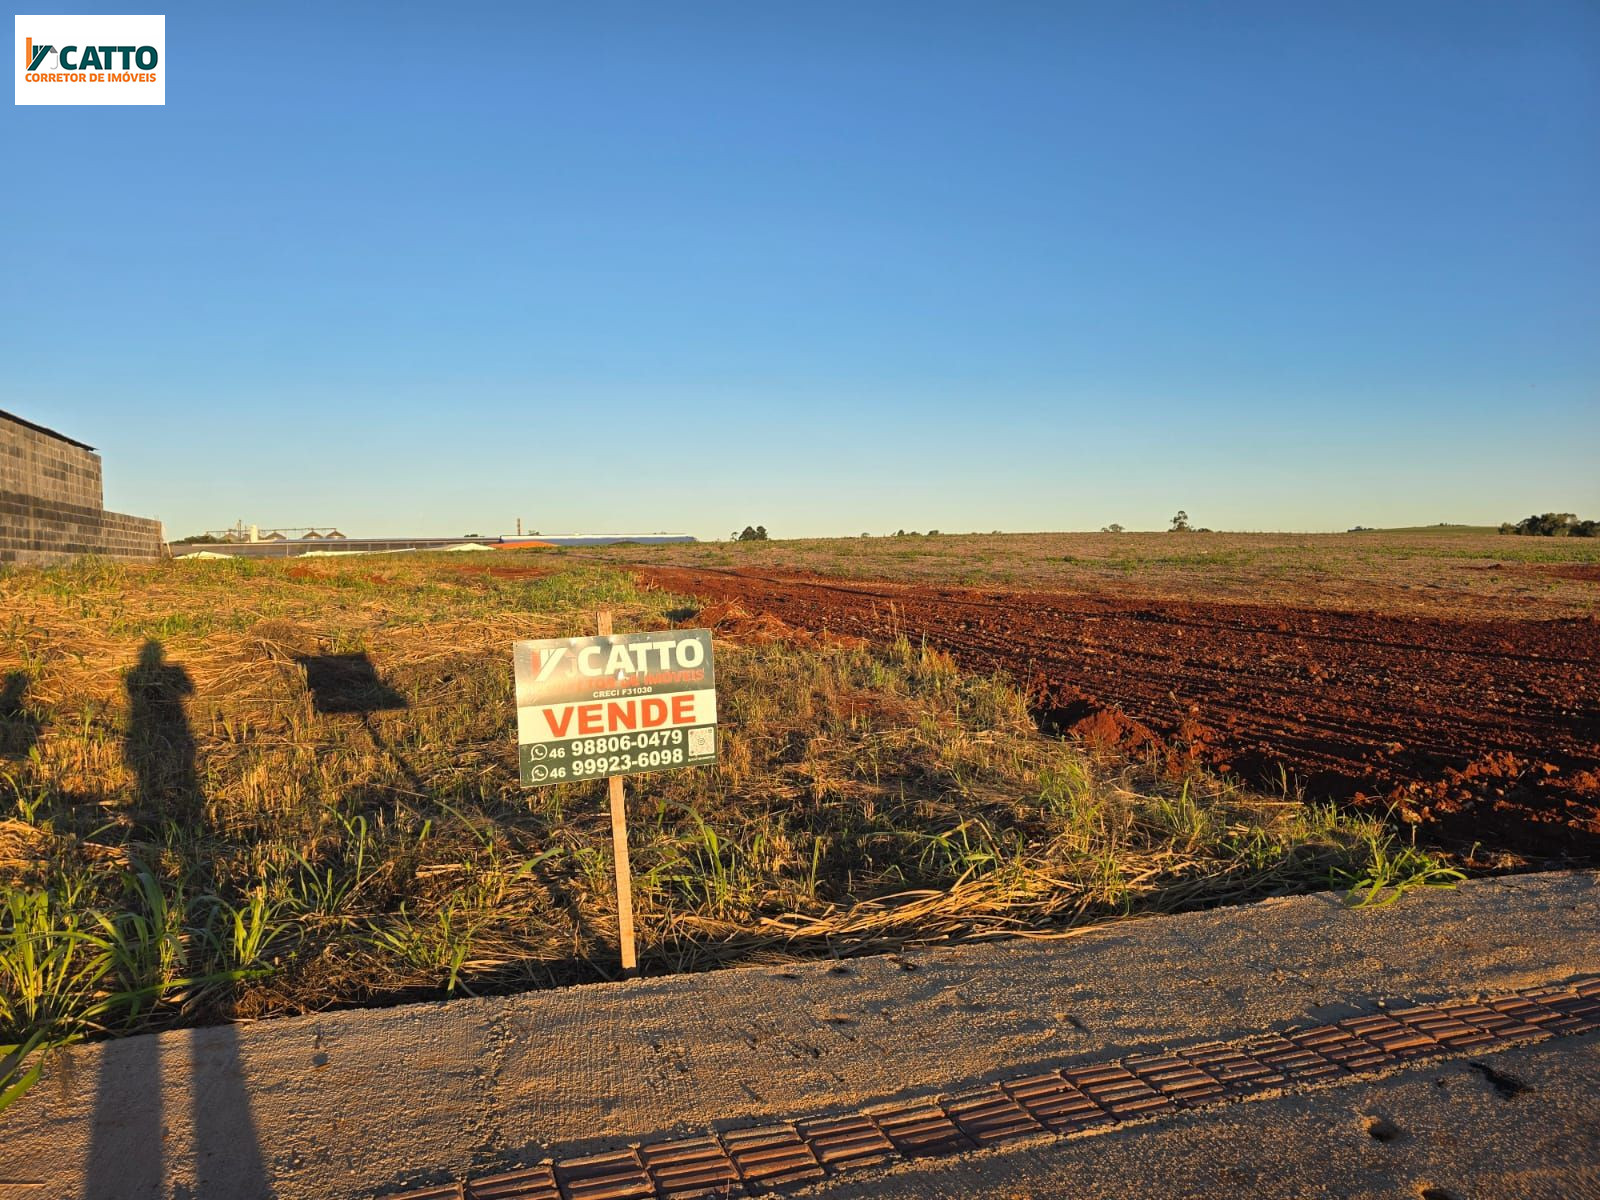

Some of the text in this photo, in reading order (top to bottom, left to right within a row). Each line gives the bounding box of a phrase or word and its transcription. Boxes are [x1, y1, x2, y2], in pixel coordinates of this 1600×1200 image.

[592, 686, 653, 699] CRECI F31030
[542, 694, 696, 738] VENDE
[549, 730, 683, 759] 46 98806-0479
[549, 749, 684, 779] 46 99923-6098
